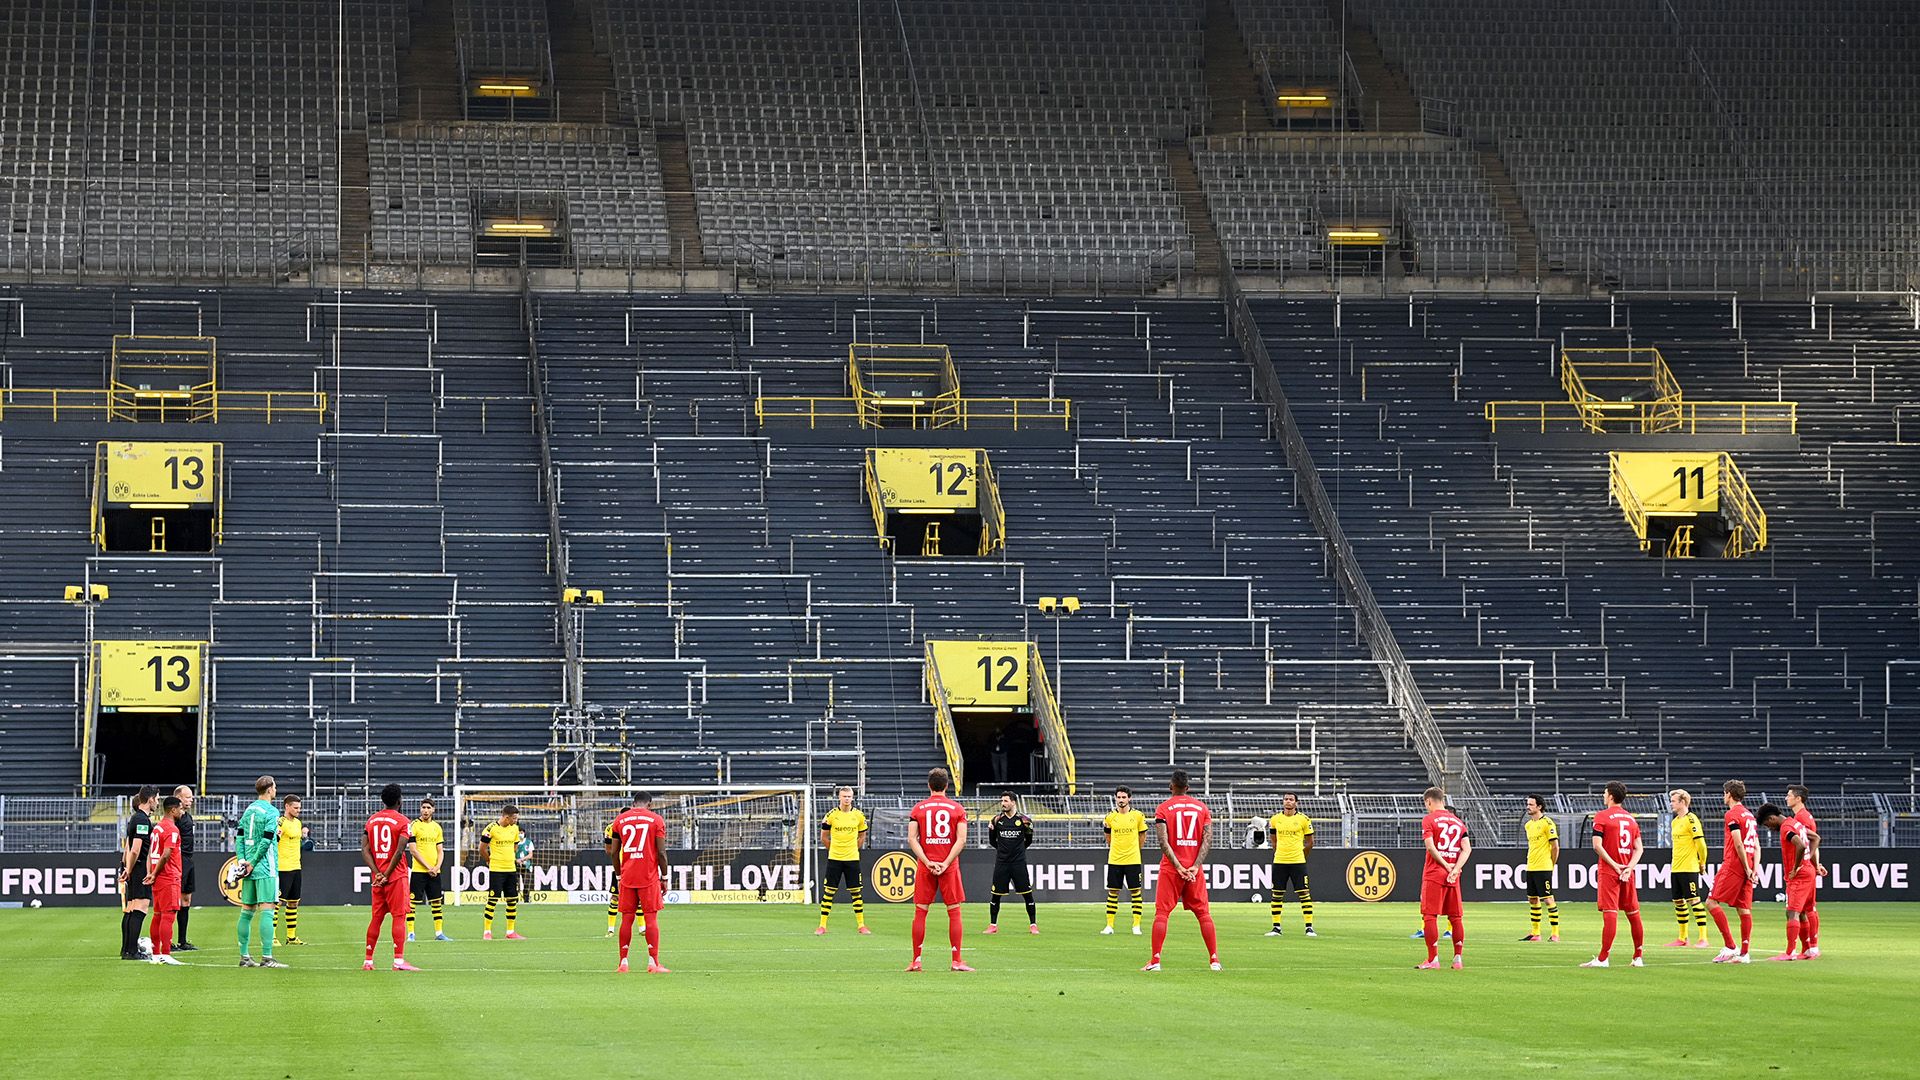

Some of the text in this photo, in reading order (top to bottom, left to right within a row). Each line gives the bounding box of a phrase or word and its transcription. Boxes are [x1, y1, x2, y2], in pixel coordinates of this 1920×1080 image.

[165, 456, 204, 490] 13
[930, 462, 967, 495] 12
[1673, 467, 1704, 499] 11
[147, 656, 191, 692] 13
[977, 656, 1019, 692] 12
[373, 824, 392, 852] 19
[925, 810, 951, 838] 18
[1176, 811, 1198, 840] 17
[1437, 822, 1462, 852] 32
[1619, 820, 1631, 848] 5
[622, 824, 649, 853] 27
[2, 868, 122, 895] FRIEDE
[724, 865, 800, 891] LOVE
[880, 857, 915, 887] BVB
[1354, 857, 1390, 887] BVB
[1475, 863, 1559, 890] FRO
[1832, 863, 1909, 889] LOVE
[1545, 880, 1551, 889] 6
[533, 892, 547, 901] 09
[777, 891, 791, 900] 09
[890, 886, 904, 896] 09
[1365, 885, 1378, 896] 09
